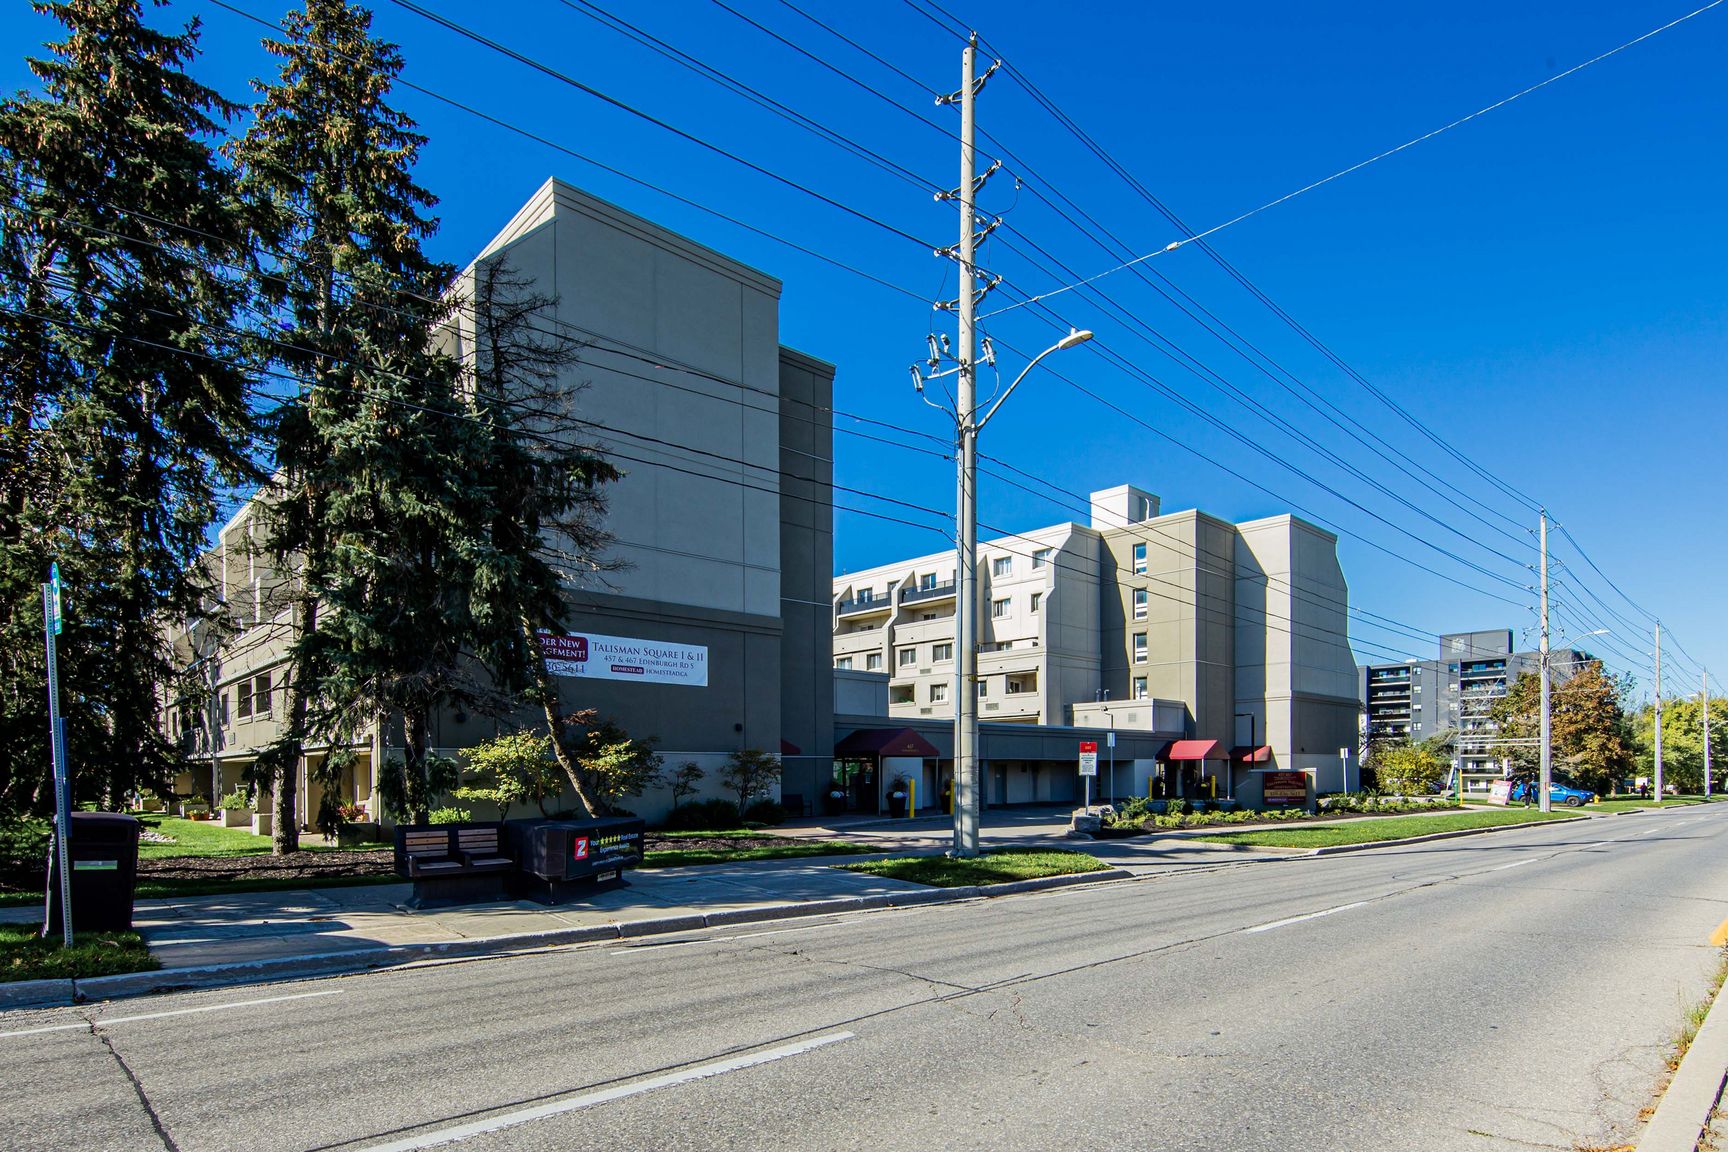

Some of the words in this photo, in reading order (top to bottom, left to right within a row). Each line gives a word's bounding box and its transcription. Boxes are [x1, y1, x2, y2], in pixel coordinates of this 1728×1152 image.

[540, 638, 556, 646] DER
[559, 639, 580, 648] NEW
[544, 647, 586, 658] GEMENT!
[592, 641, 640, 655] TALISMAN
[643, 647, 678, 659] SQUARE
[681, 651, 684, 659] I
[687, 652, 694, 660] &
[696, 653, 703, 661] II
[639, 658, 677, 668] EDINBURGH
